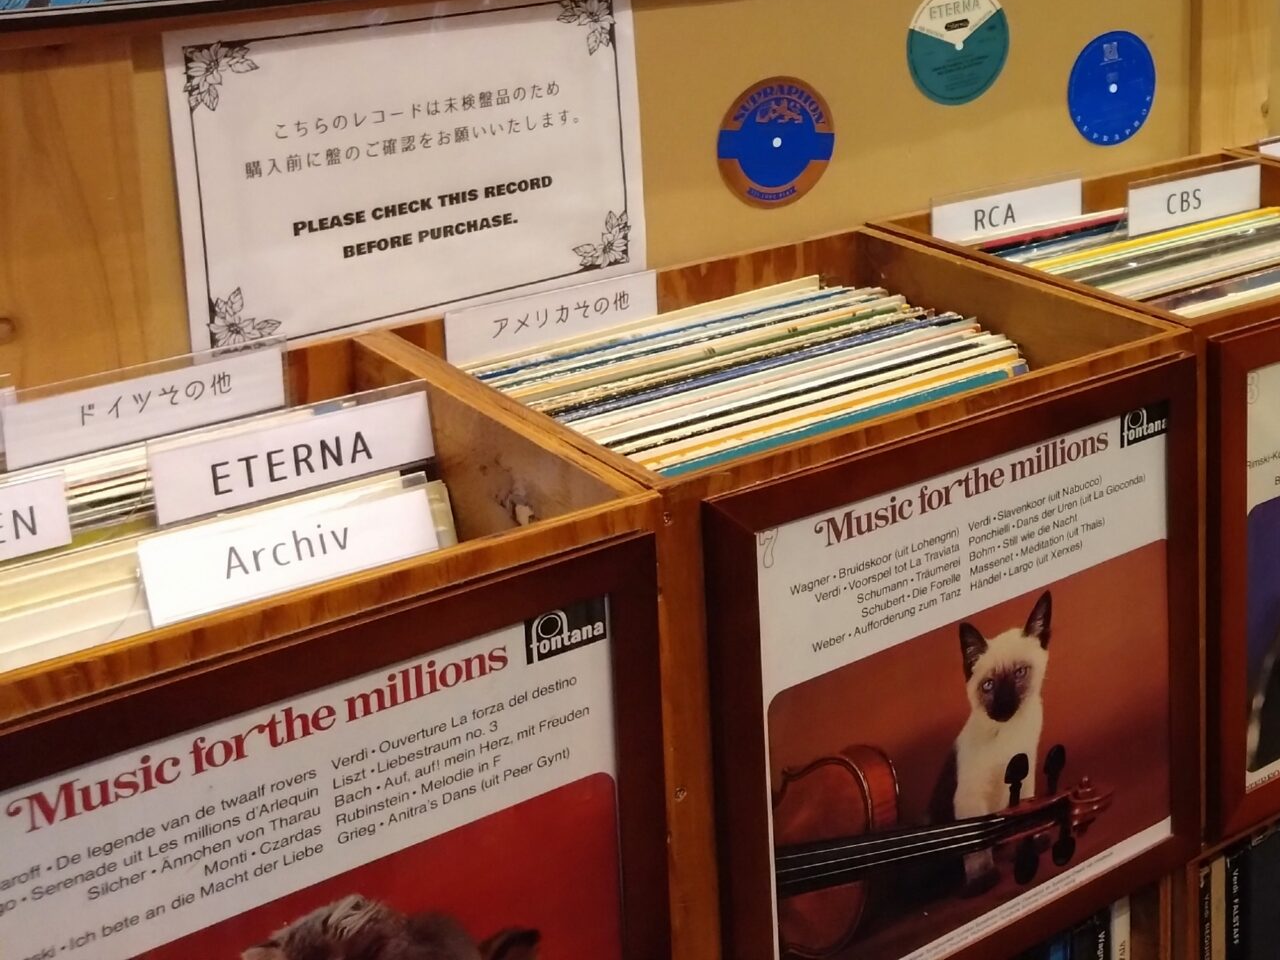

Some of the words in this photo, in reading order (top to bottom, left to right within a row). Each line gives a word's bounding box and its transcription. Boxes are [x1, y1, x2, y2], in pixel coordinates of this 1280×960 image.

[733, 84, 826, 124] SUPRAPHON
[244, 108, 582, 181] 購入前に盤のご確認をお願いいたします。
[292, 208, 367, 237] PLEASE
[371, 195, 433, 221] CHECK
[437, 188, 479, 210] THIS
[484, 174, 553, 199] RECORD
[972, 202, 1017, 232] RCA
[1165, 187, 1203, 216] CBS
[342, 233, 413, 260] BEFORE
[417, 212, 519, 243] PURCHASE.
[492, 290, 632, 340] アメリカその他
[80, 372, 233, 428] ドイツその他
[209, 430, 375, 497] ETERNA
[814, 495, 914, 549] Music
[917, 478, 964, 516] for
[961, 463, 1005, 501] the
[1009, 431, 1110, 481] millions
[224, 524, 351, 580] Archiv
[967, 515, 993, 532] Verdi
[789, 573, 831, 597] Wagner
[838, 553, 893, 580] Bruidskoor
[894, 546, 909, 560] (uit
[910, 526, 961, 553] Lohengrin)
[814, 587, 841, 603] Verdi
[848, 566, 892, 592] Voorspel
[894, 561, 907, 573] tot
[910, 557, 922, 570] La
[924, 542, 961, 563] Traviata
[856, 578, 909, 605] Schumann
[861, 593, 906, 619] Schubert
[911, 584, 928, 599] Die
[930, 572, 962, 592] Forelle
[528, 611, 607, 663] fontana
[5, 754, 182, 833] Music
[191, 724, 269, 777] for
[263, 702, 338, 750] the
[345, 645, 509, 724] millions
[331, 747, 369, 771] Verdi
[378, 721, 448, 754] Ouverture
[450, 714, 468, 729] La
[471, 701, 505, 721] forza
[508, 691, 529, 708] del
[531, 674, 578, 700] destino
[332, 768, 368, 790] Liszt
[377, 736, 462, 774] Liebestraum
[464, 728, 487, 742] no.
[488, 720, 499, 733] 3
[334, 785, 373, 808] Bach
[413, 762, 441, 780] auf!
[443, 749, 477, 769] mein
[479, 735, 515, 755] Herz,
[516, 726, 536, 742] mit
[538, 705, 591, 733] Freuden
[54, 852, 83, 873] De
[86, 824, 157, 860] legende
[159, 814, 192, 834] van
[194, 802, 217, 821] de
[219, 782, 267, 813] twaalf
[269, 768, 318, 795] rovers
[336, 791, 411, 828] Rubinstein
[420, 768, 475, 796] Melodie
[476, 761, 490, 775] in
[492, 753, 502, 769] F
[337, 822, 378, 846] Grieg
[386, 798, 439, 826] Anitra's
[442, 784, 478, 806] Dans
[479, 775, 501, 793] (uit
[503, 762, 534, 783] Peer
[536, 746, 571, 769] Gynt)
[30, 859, 119, 902] Serenade
[122, 847, 144, 868] uit
[147, 837, 179, 861] Les
[183, 812, 242, 846] millions
[245, 785, 320, 821] d'Arlequin
